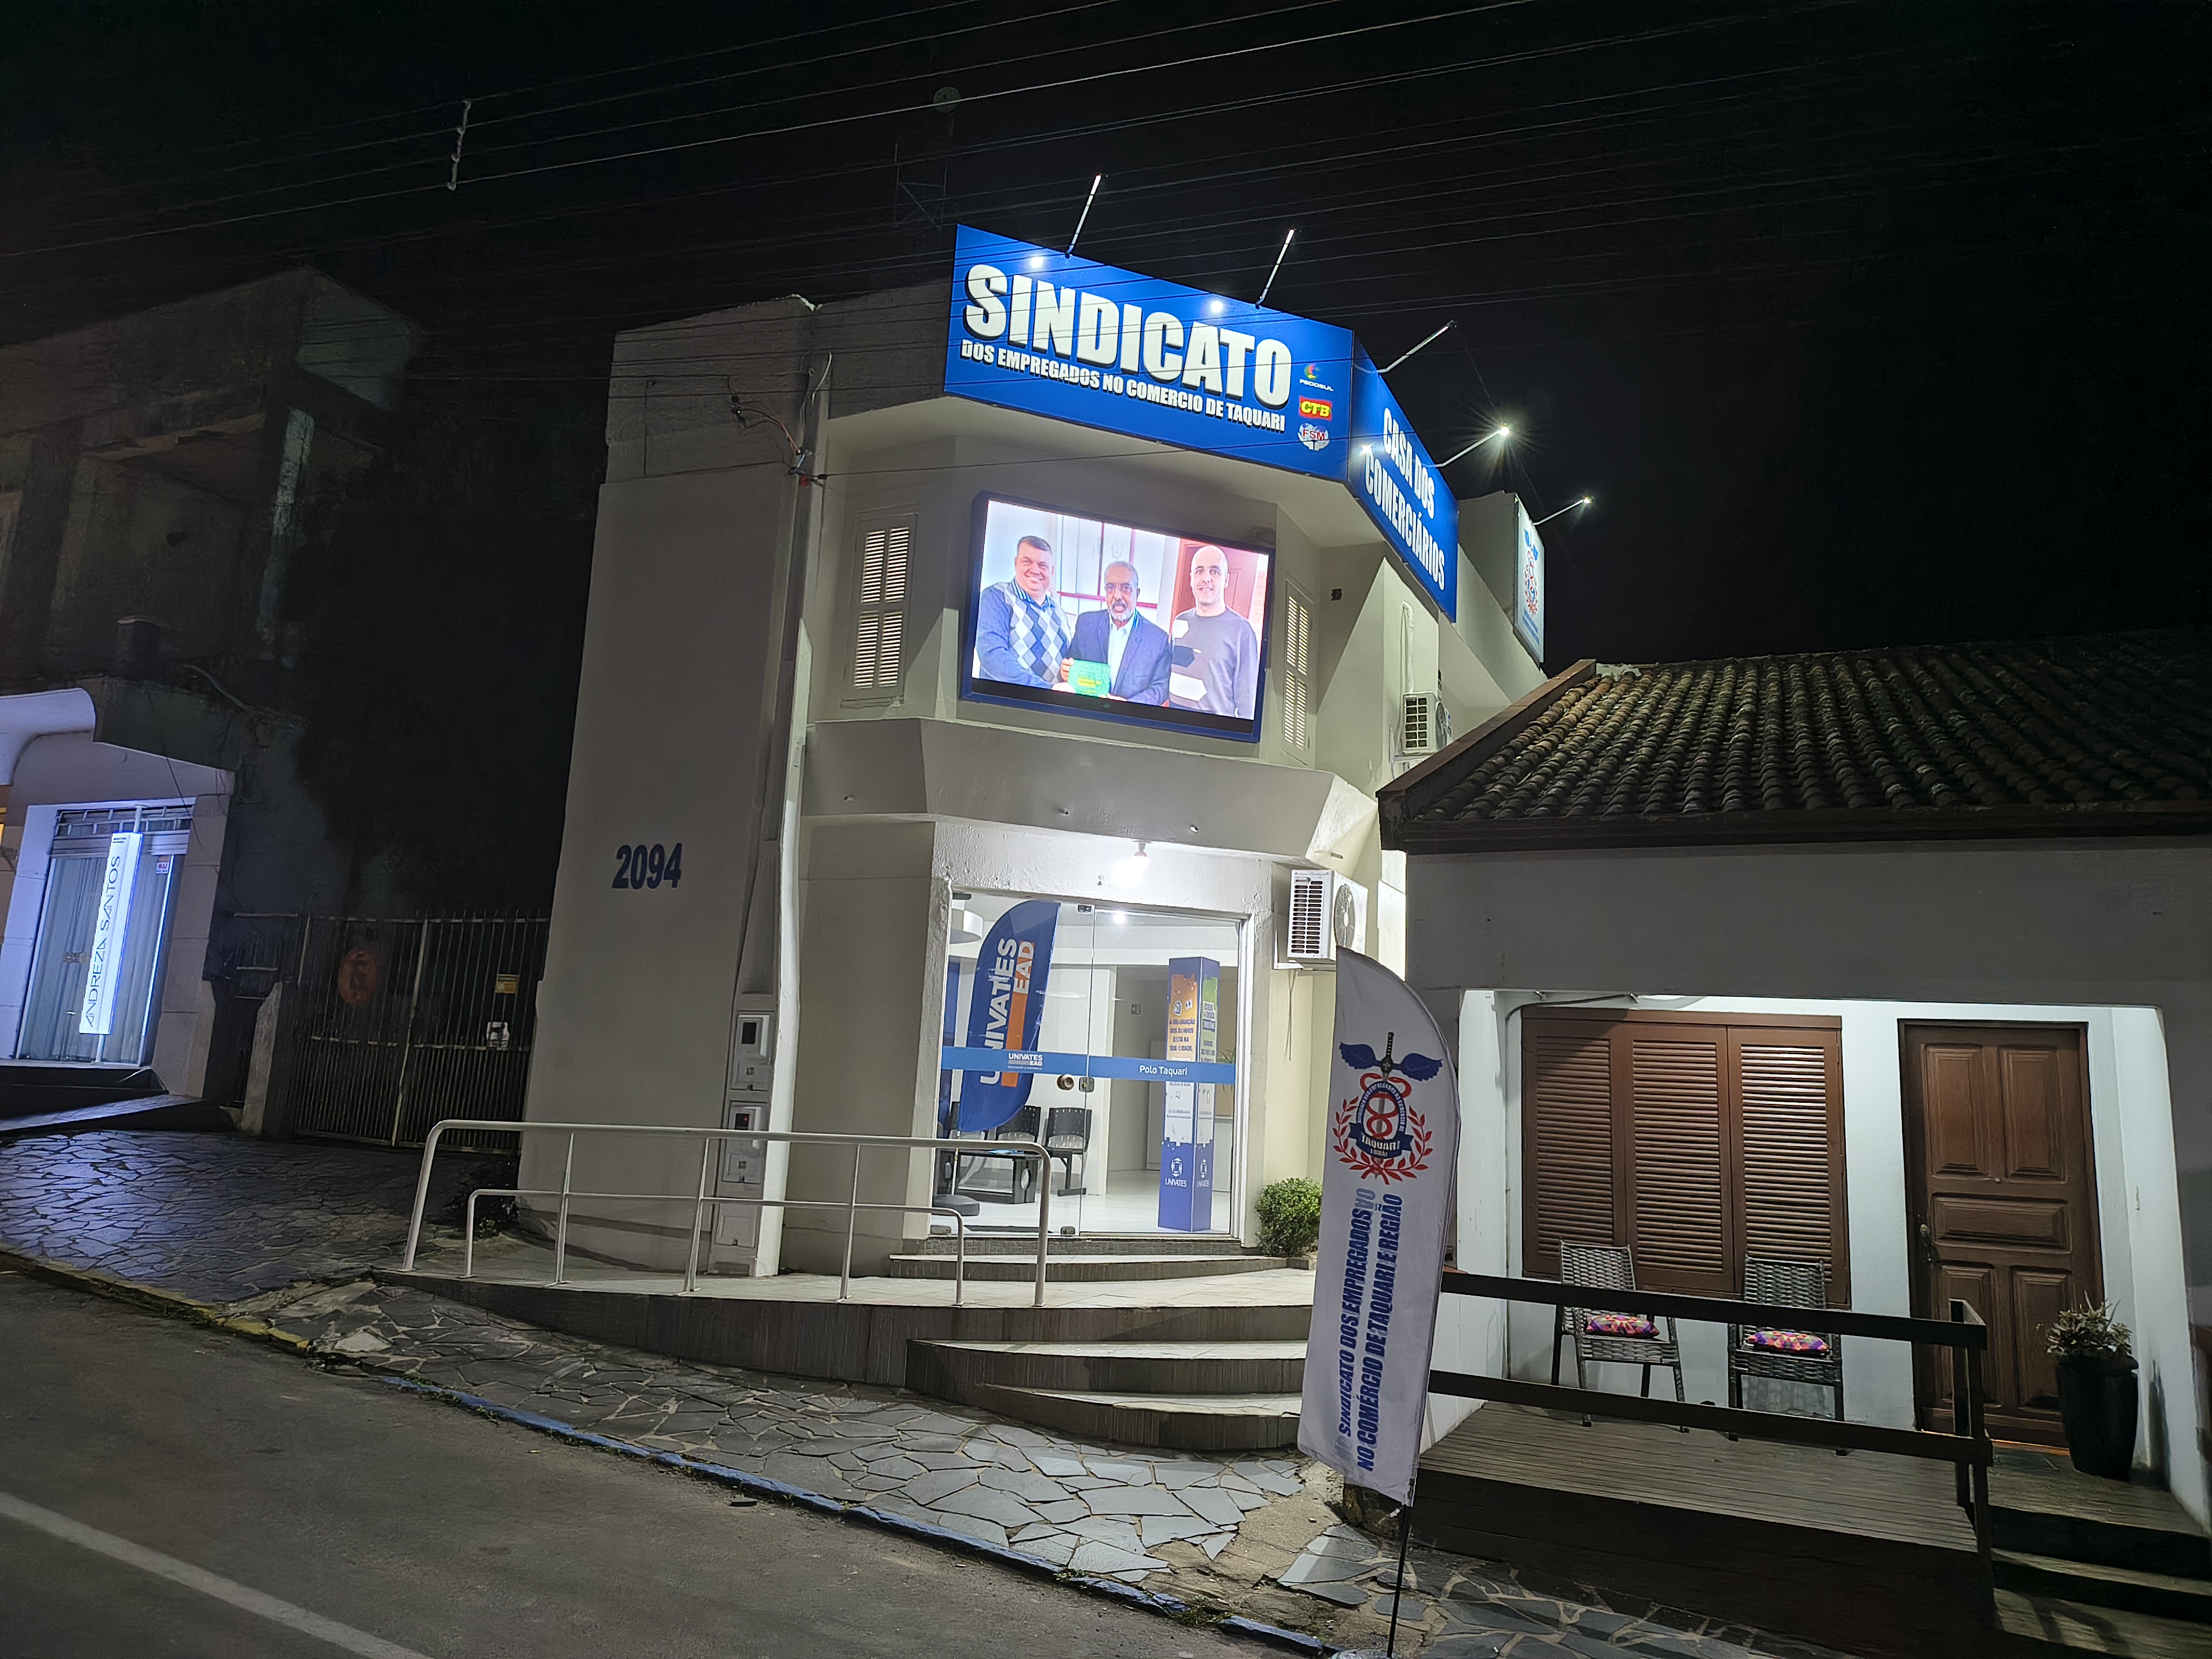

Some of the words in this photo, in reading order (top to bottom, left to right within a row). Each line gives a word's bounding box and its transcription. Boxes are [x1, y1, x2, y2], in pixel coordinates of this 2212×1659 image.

[965, 264, 1292, 406] SINDICATO
[961, 339, 995, 363] DOS
[997, 347, 1101, 389] EMPREGADOS
[1102, 373, 1124, 394] NO
[1126, 379, 1203, 413] COMERCIO
[1205, 397, 1224, 417] DE
[1226, 402, 1285, 432] TAQUARI
[1301, 401, 1330, 417] CTB
[1303, 429, 1326, 441] FSM
[1383, 408, 1413, 488] CASA
[1414, 454, 1435, 519] DOS
[1365, 447, 1445, 590] COMERCIÁRIOS
[612, 843, 682, 889] 2094
[85, 938, 107, 1028] ANDREZA
[100, 856, 120, 931] SANTOS
[1013, 941, 1035, 994] EAD
[1008, 1053, 1043, 1061] UNIVATES
[1139, 1065, 1157, 1074] Polo
[1159, 1066, 1188, 1077] Taquari
[1361, 1133, 1400, 1151] TAQUARI
[1378, 1193, 1402, 1251] REGIÃO
[1342, 1208, 1372, 1314] EMPREGADOS
[1377, 1251, 1398, 1264] E
[1367, 1263, 1396, 1332] TAQUARI
[1340, 1313, 1359, 1350] DOS
[1365, 1332, 1387, 1358] DE
[1339, 1349, 1355, 1437] SINDICATO
[1356, 1356, 1383, 1445] COMÉRCIO
[1357, 1445, 1375, 1472] NO
